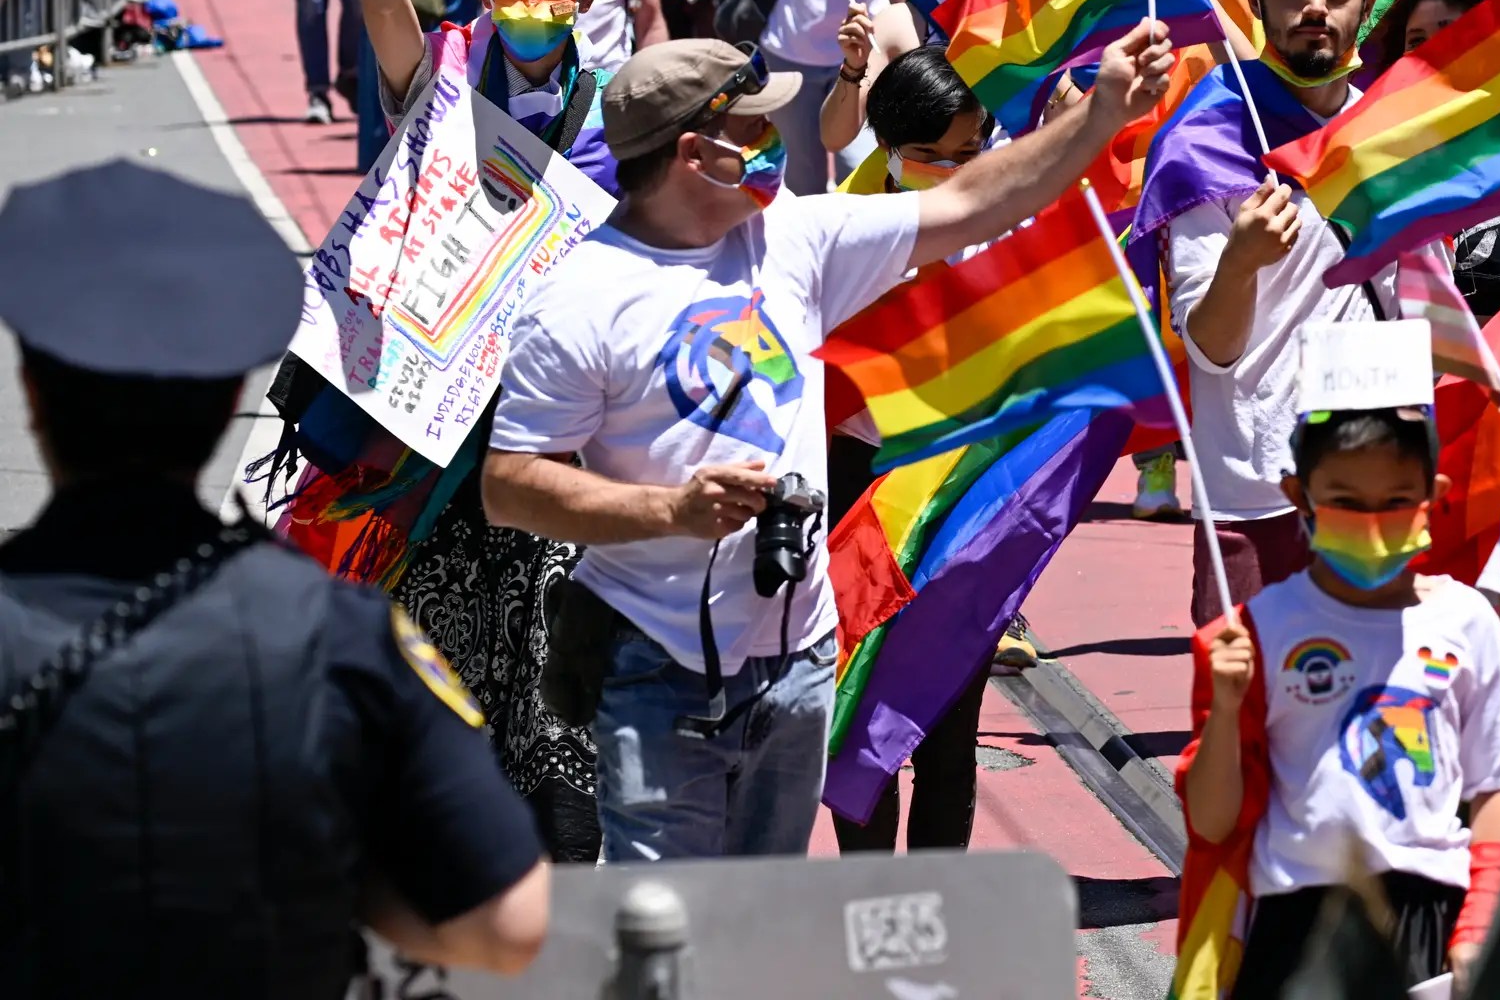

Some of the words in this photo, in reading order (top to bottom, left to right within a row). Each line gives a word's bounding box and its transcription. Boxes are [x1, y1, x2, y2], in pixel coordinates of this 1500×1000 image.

[342, 167, 399, 239] HAS
[396, 74, 461, 184] SHOWN
[343, 265, 380, 306] ALL
[379, 149, 451, 245] RIGHTS
[367, 269, 407, 320] ARE
[402, 235, 425, 263] AT
[421, 161, 480, 235] STAKE
[491, 300, 515, 336] BILL
[517, 278, 526, 299] OF
[529, 203, 581, 275] HUMAN
